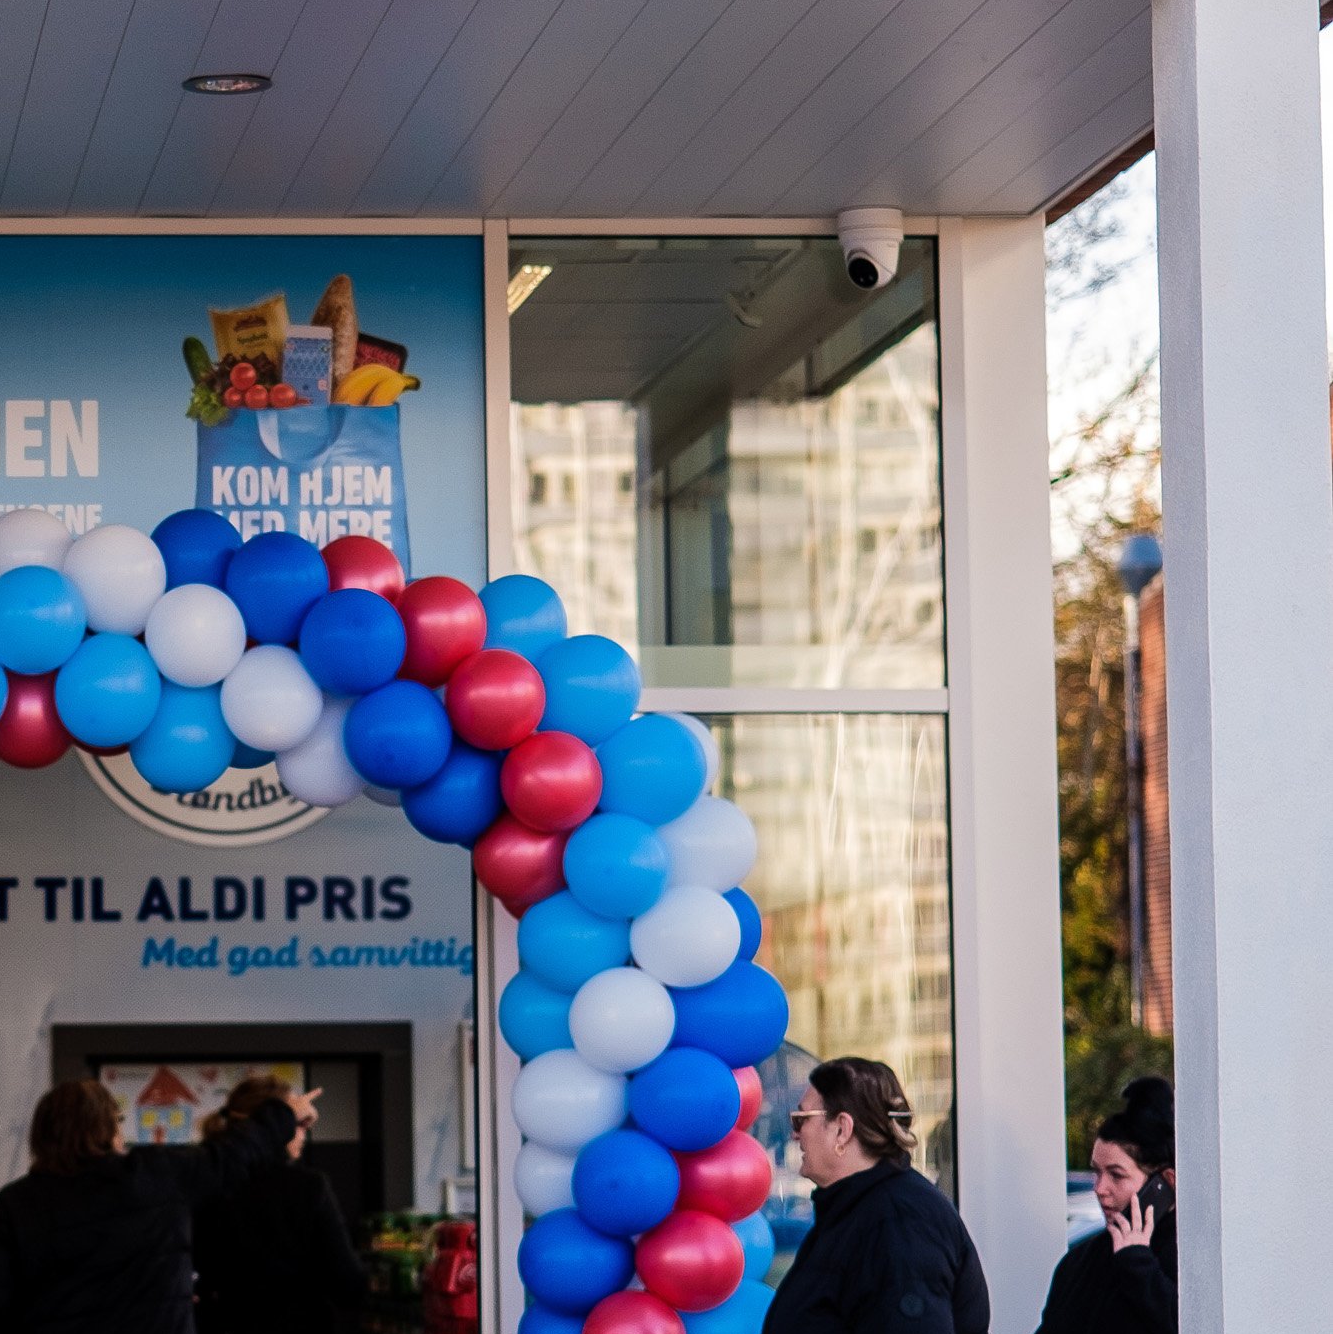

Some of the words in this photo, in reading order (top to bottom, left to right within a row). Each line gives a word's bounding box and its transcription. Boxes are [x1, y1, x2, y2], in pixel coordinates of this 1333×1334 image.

[212, 465, 288, 506] KOM
[300, 466, 392, 506] HJEM
[33, 877, 122, 922] TIL
[135, 877, 265, 922] ALDI
[284, 877, 412, 922] PRIS
[141, 935, 220, 967] Med
[228, 935, 299, 977] god
